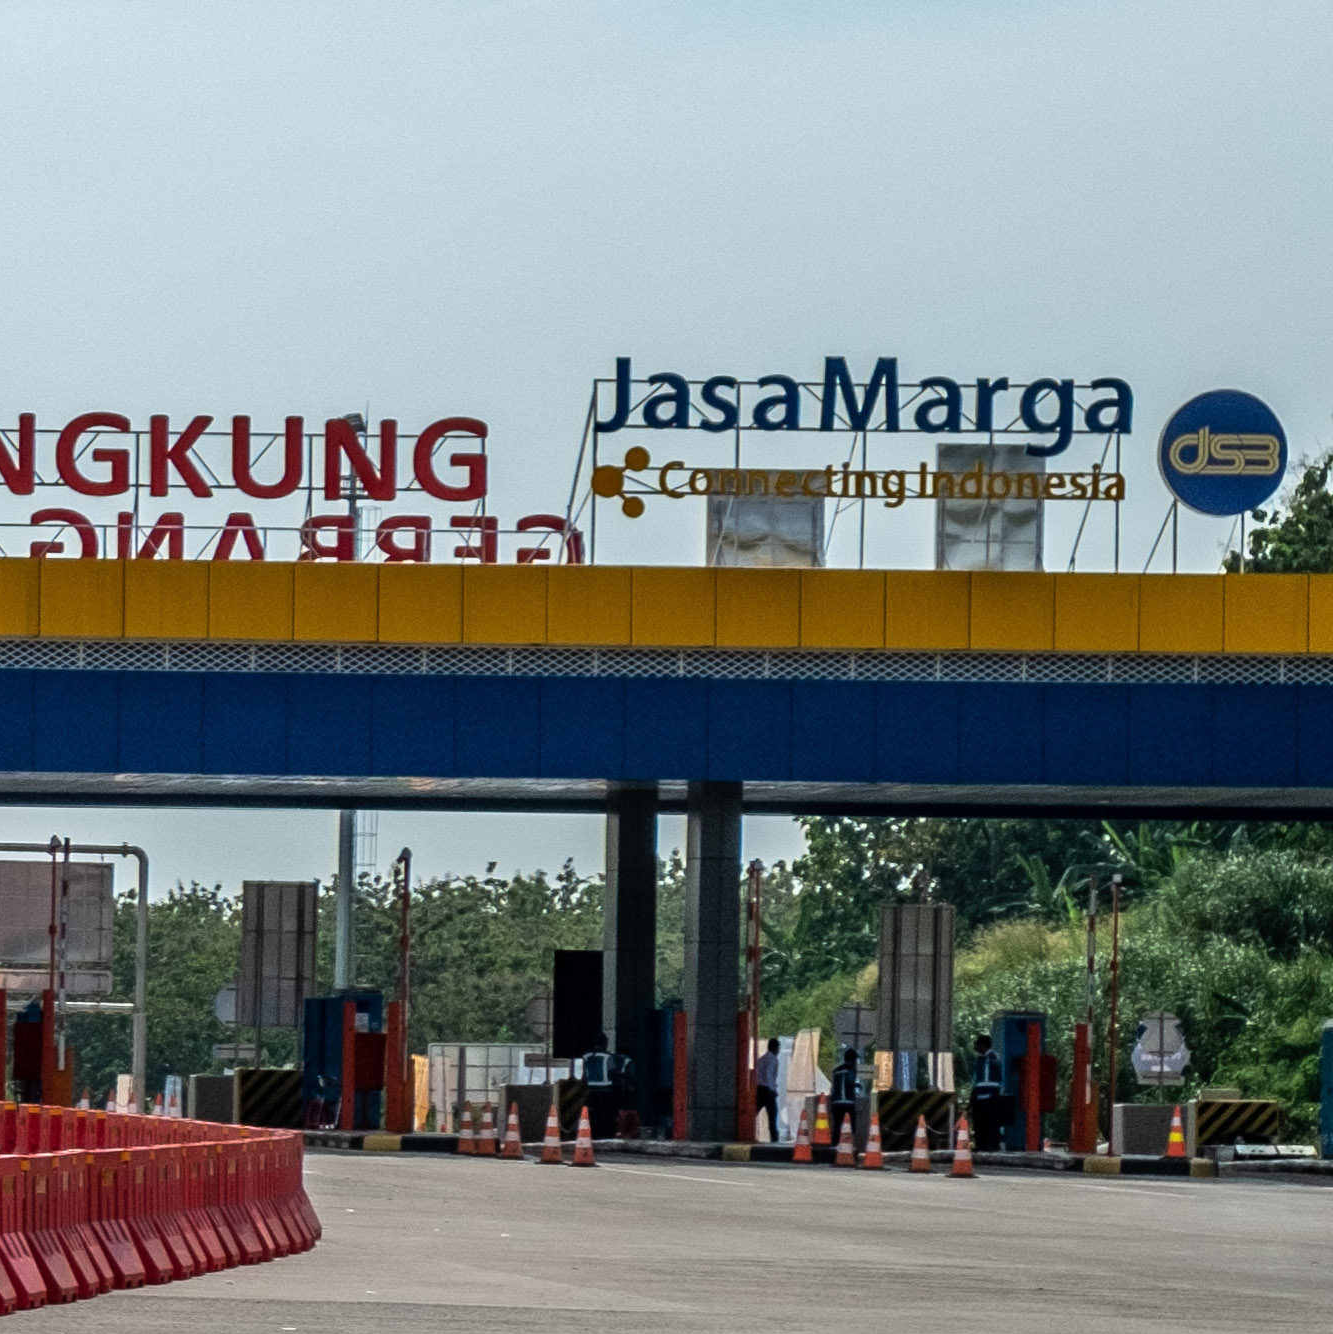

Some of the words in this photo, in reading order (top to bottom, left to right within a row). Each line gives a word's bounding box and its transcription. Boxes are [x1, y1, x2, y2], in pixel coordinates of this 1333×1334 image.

[594, 356, 802, 433] Jasa
[820, 356, 1133, 457] Marga
[659, 460, 907, 508] Connecting
[920, 461, 1126, 502] Indonesia
